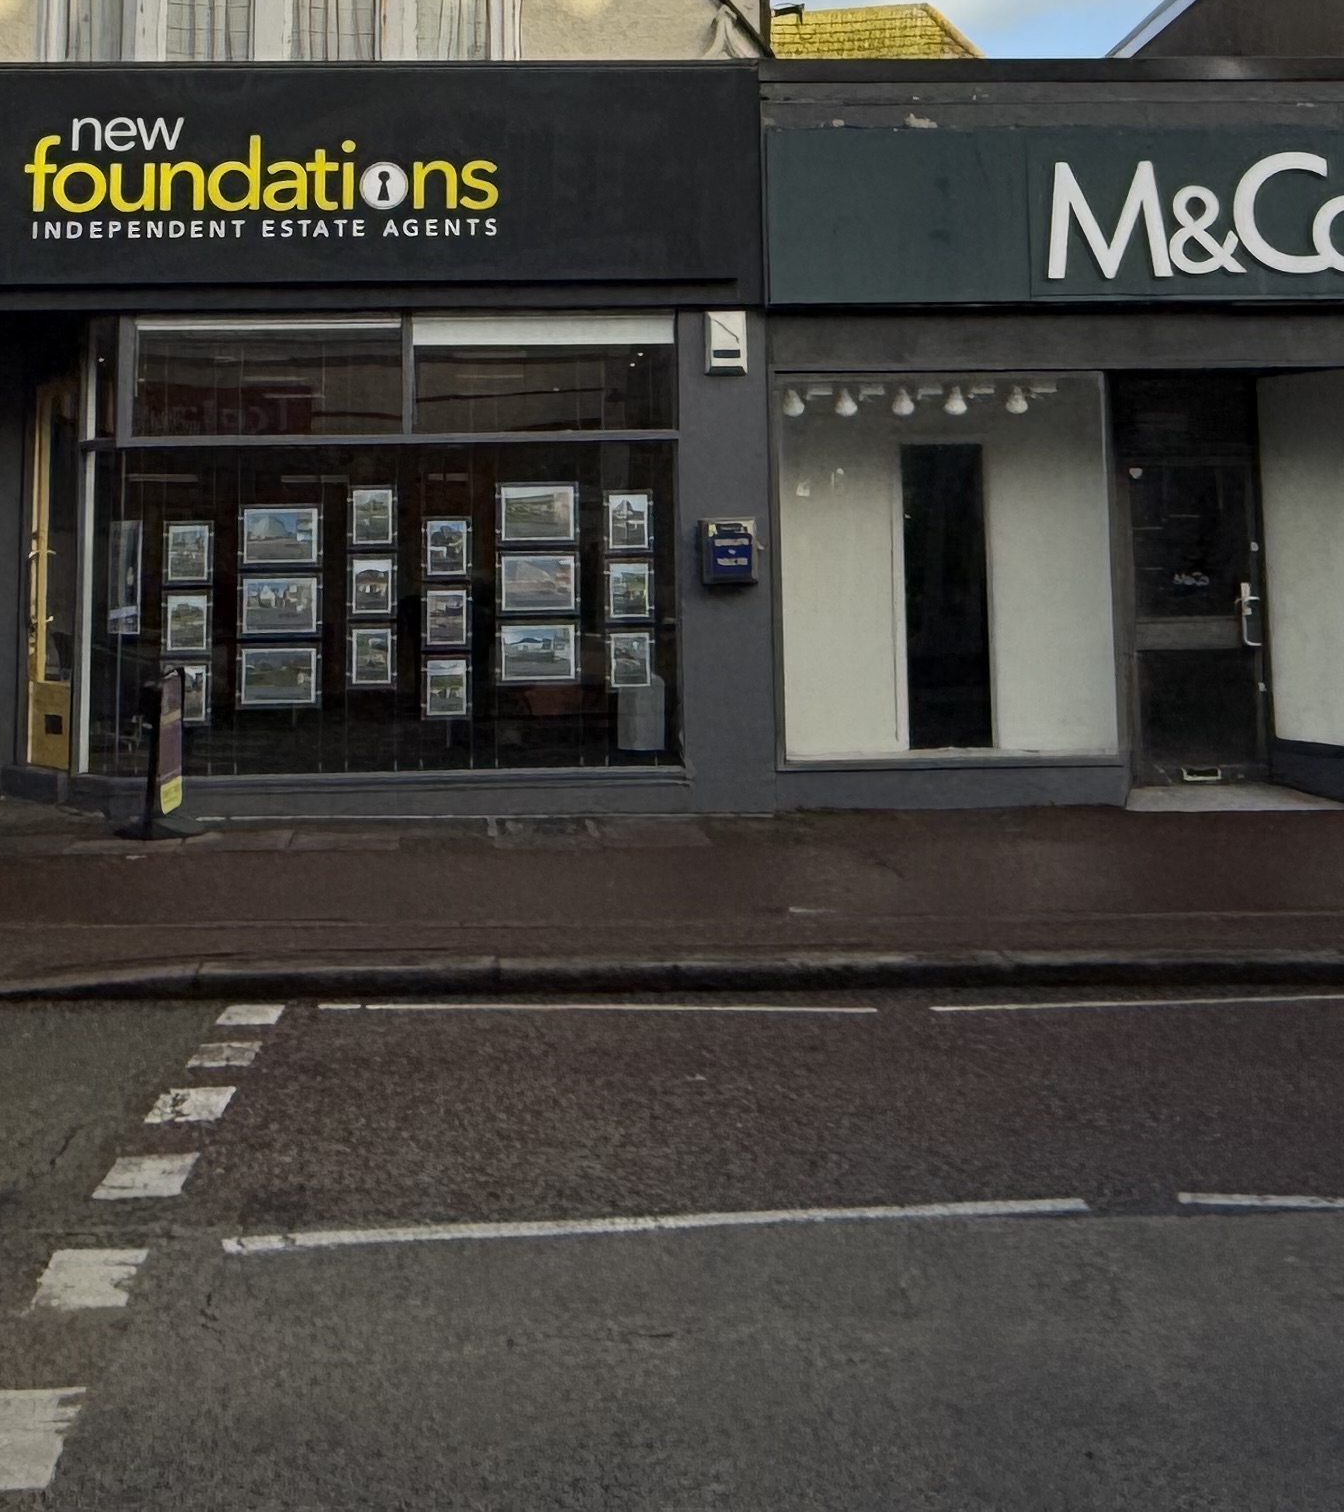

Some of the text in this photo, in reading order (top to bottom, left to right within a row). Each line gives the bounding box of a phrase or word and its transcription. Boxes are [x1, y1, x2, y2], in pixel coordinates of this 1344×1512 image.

[71, 116, 185, 152] new
[24, 134, 500, 213] foundations
[32, 218, 499, 240] INDEPENDENT ESTATE AGENTS
